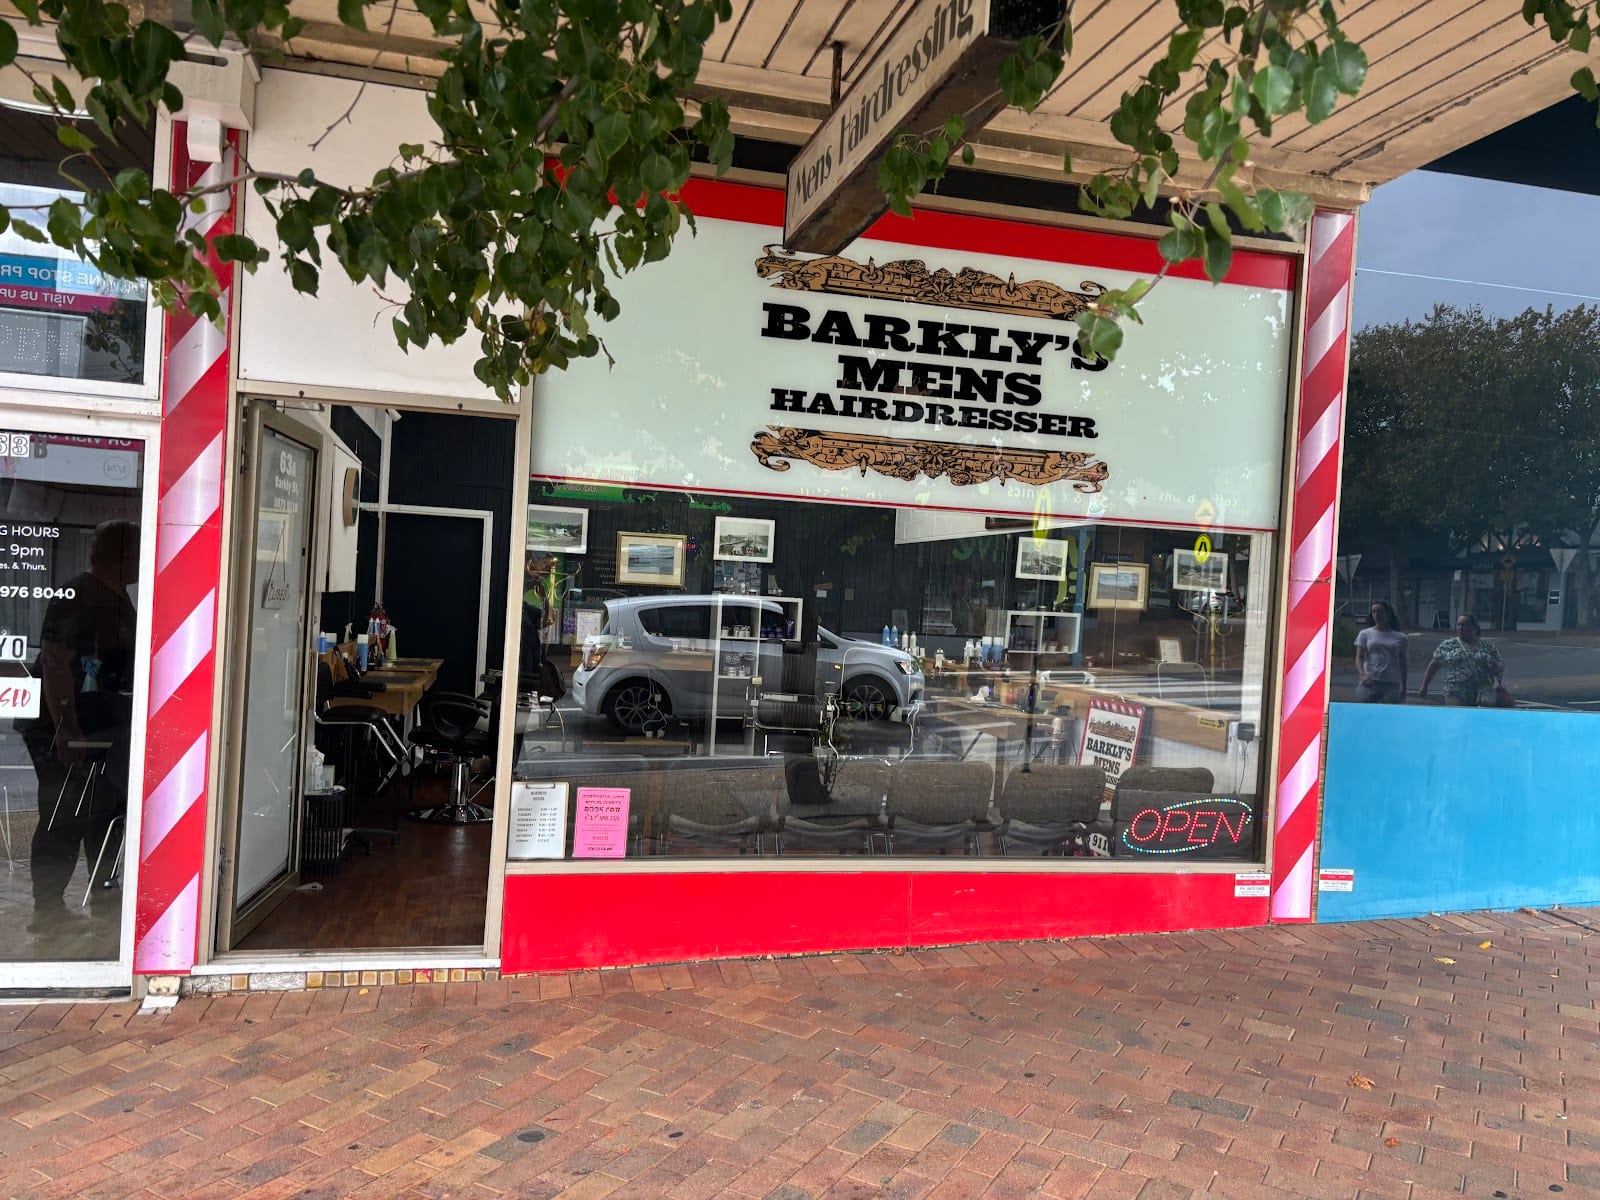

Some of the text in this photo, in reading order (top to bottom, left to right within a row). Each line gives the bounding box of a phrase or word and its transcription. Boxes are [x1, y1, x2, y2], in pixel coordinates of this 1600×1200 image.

[791, 145, 833, 217] Mens
[836, 354, 1042, 407] MENS
[769, 387, 1099, 440] HAIRDRESSER
[11, 525, 60, 538] HOURS
[10, 544, 45, 559] 9pm
[12, 562, 20, 570] &
[21, 562, 48, 571] Thurs.
[0, 586, 76, 600] 976 8040
[1086, 737, 1133, 762] BARKLY'S
[1093, 755, 1121, 775] MENS
[1131, 809, 1246, 843] OPEN
